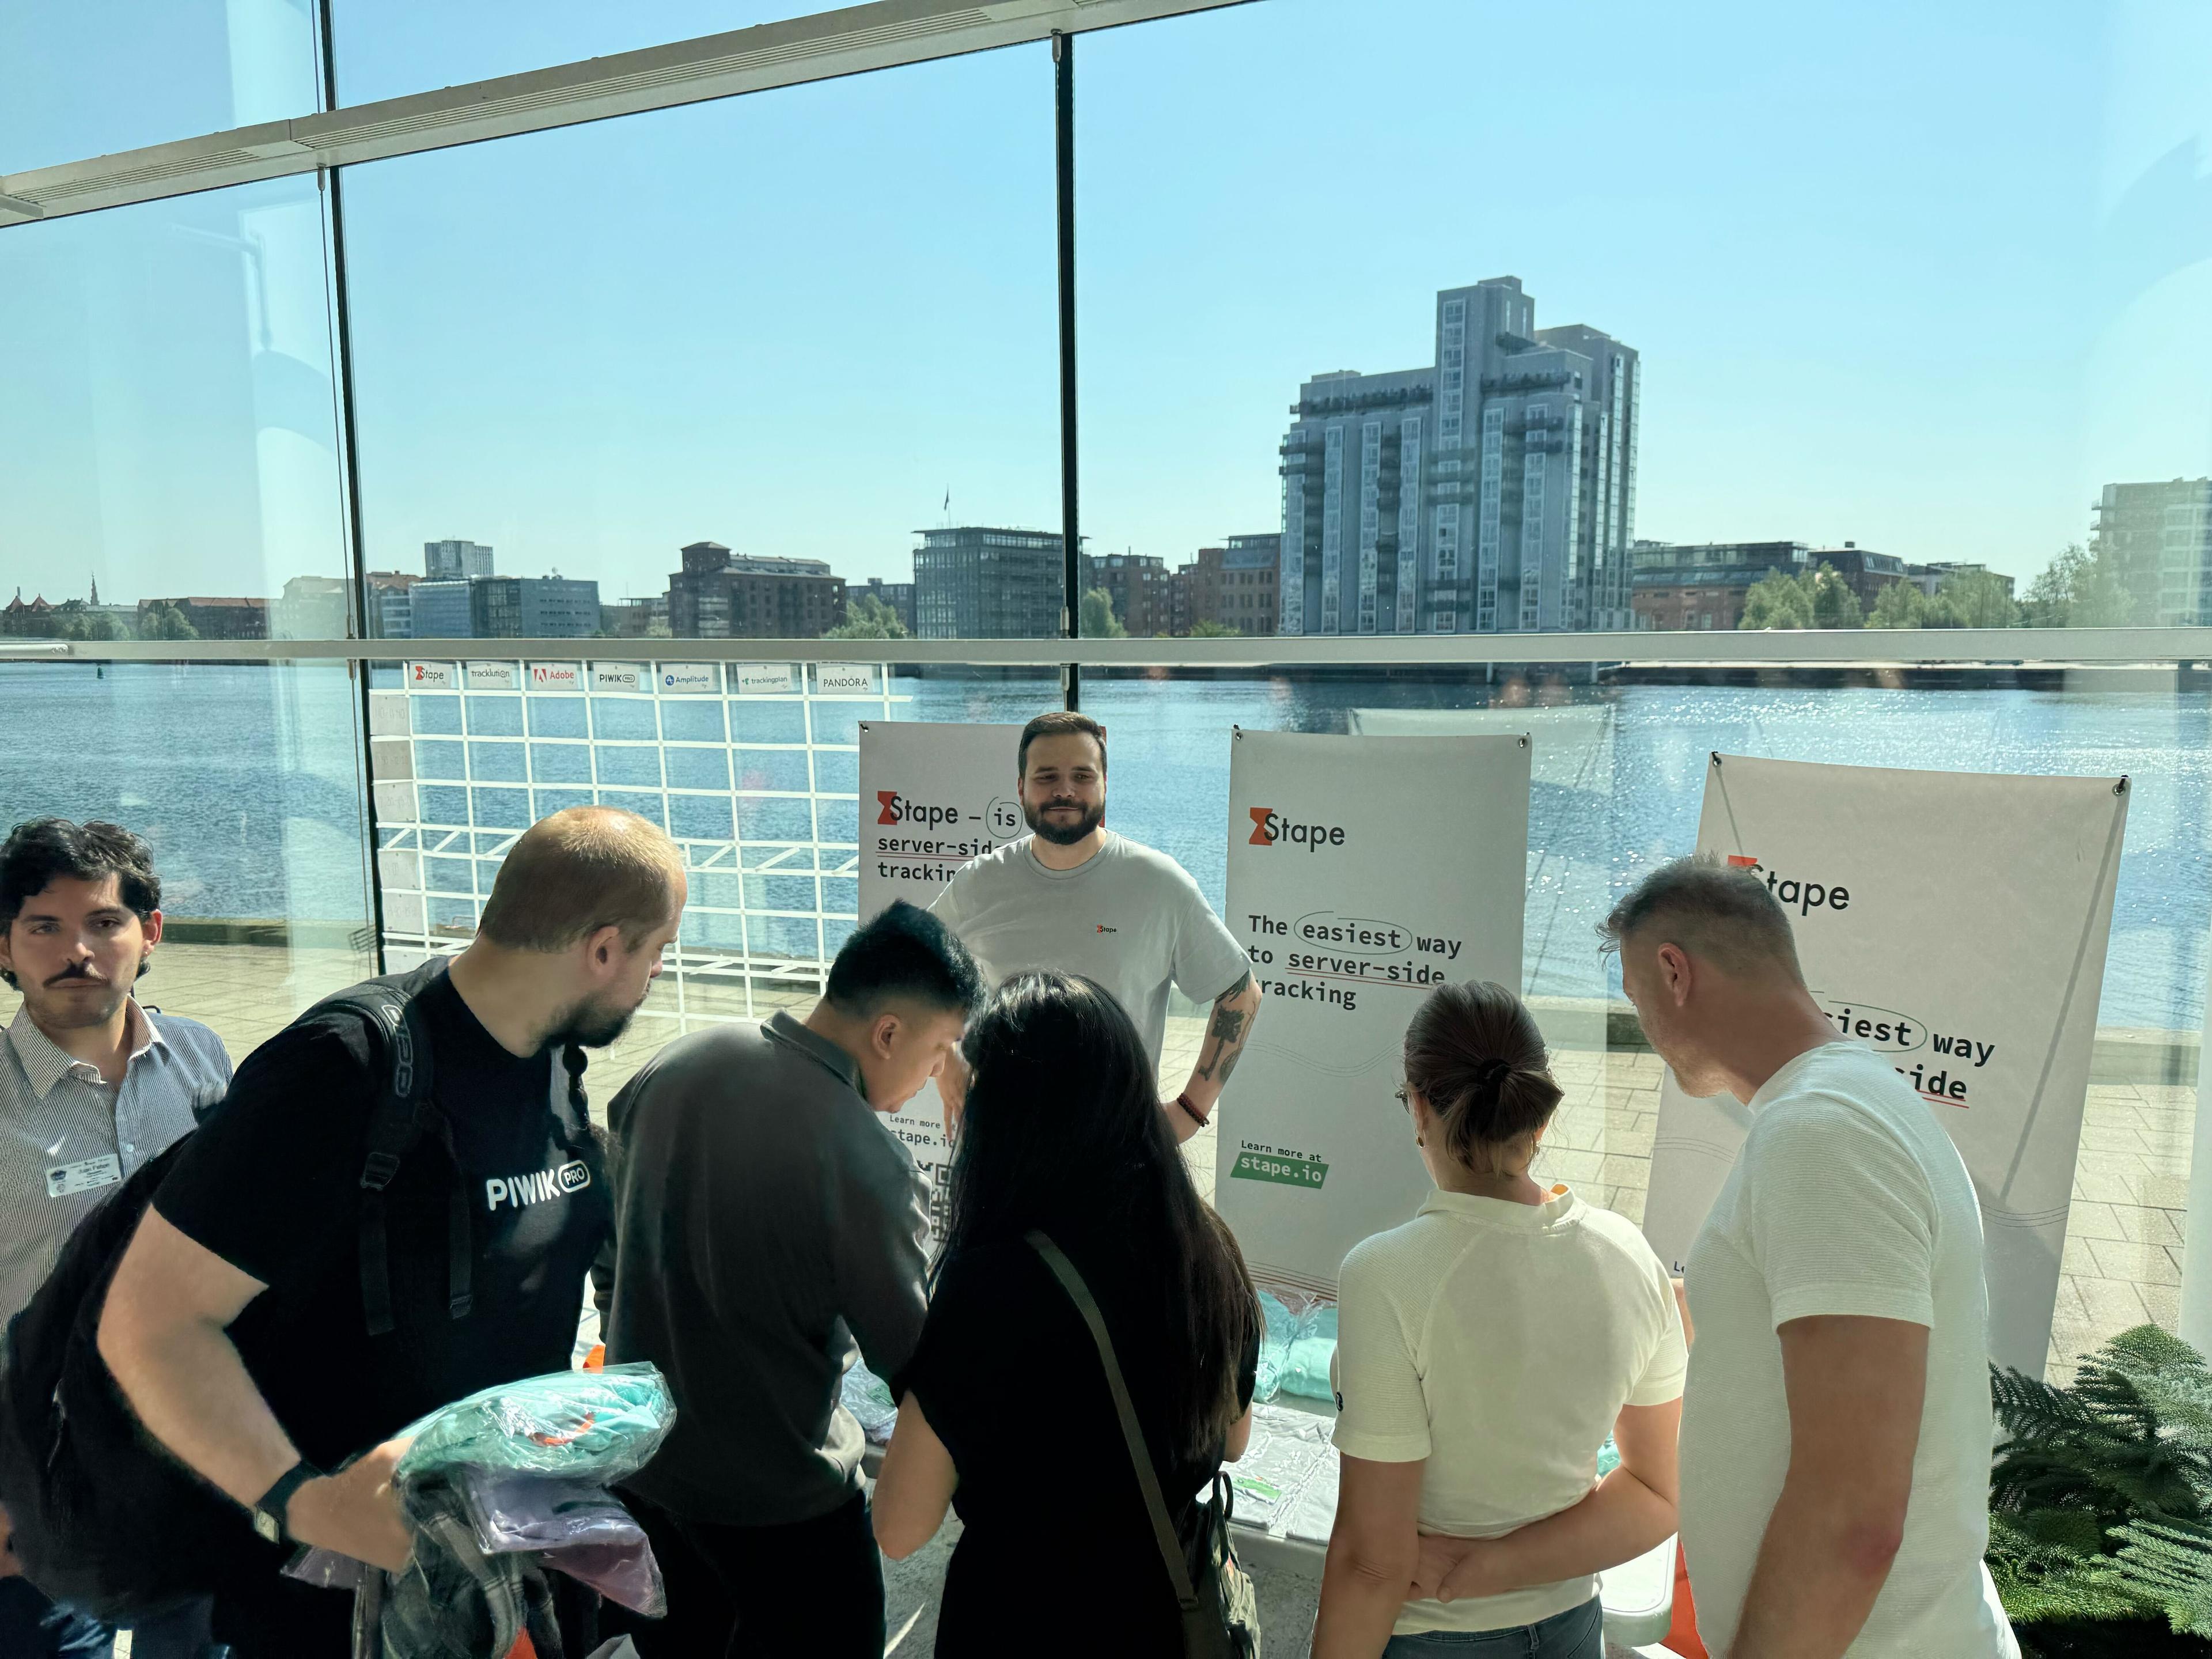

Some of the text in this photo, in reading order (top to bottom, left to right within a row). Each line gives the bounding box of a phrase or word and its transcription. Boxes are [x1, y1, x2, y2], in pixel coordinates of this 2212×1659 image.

[421, 668, 444, 682] Stape
[550, 670, 574, 679] Adobe
[600, 674, 622, 683] PIWIK
[675, 675, 709, 684] Amplitude
[751, 676, 788, 684] trackingplan
[890, 796, 959, 831] Stape
[993, 808, 1016, 827] is
[1264, 813, 1346, 853] Stape
[877, 838, 1002, 856] server-sid
[877, 861, 956, 882] trackin
[1751, 863, 1850, 916] tape
[1248, 914, 1462, 960] The easiest way
[1248, 945, 1445, 985] to server-side
[1256, 979, 1357, 1011] racking
[1823, 1008, 1995, 1067] iest way
[889, 1114, 915, 1126] Learn
[919, 1120, 941, 1129] more
[1241, 1140, 1321, 1162] Learn more at
[1241, 1156, 1322, 1183] stape.io
[486, 1166, 585, 1211] PIWIK PRO
